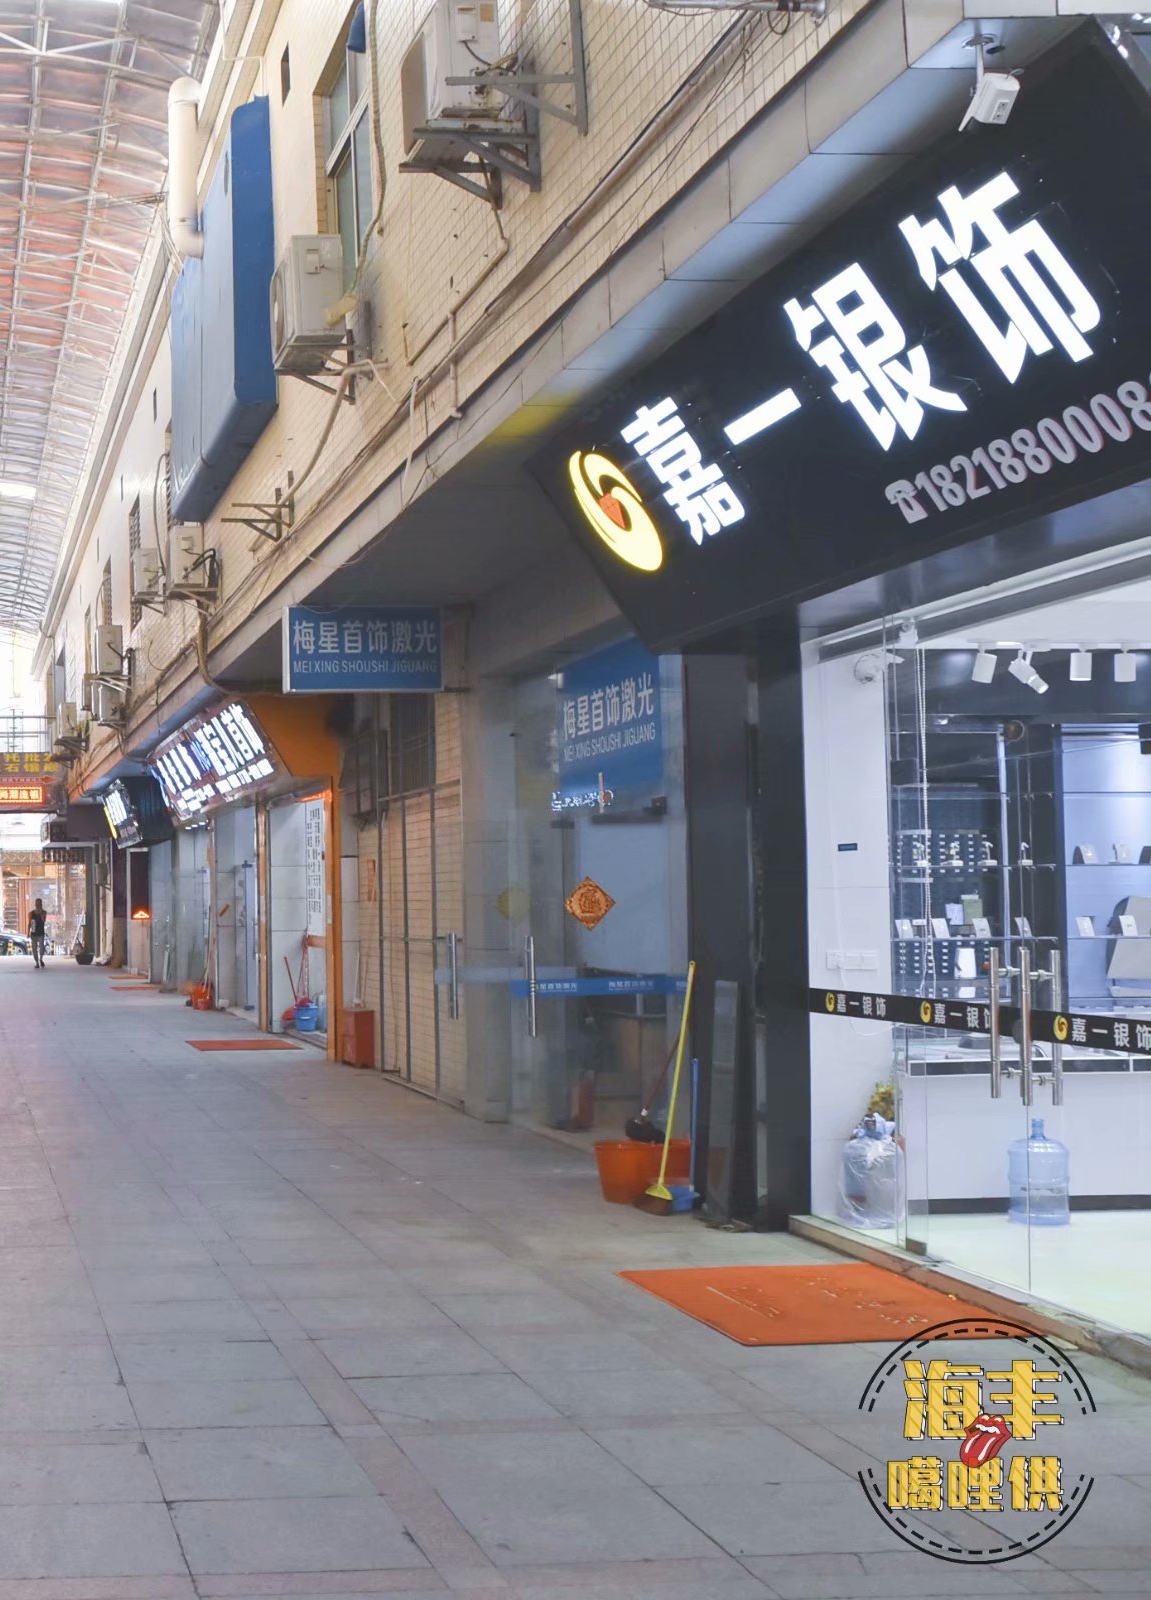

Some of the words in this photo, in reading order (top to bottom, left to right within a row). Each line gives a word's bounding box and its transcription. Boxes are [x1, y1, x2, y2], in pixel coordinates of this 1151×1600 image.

[620, 172, 1101, 546] 嘉一银饰
[914, 372, 1151, 513] 1821880008
[293, 620, 437, 655] 梅星首饰激光
[293, 660, 312, 673] MEI
[315, 660, 339, 673] XING
[342, 660, 389, 673] SHOUSHI
[392, 660, 437, 673] JIGUANG
[563, 672, 654, 741] 梅星首饰激光
[575, 740, 591, 758] XING
[592, 732, 621, 756] SHOUSHI
[623, 722, 655, 748] JIGUANG
[837, 993, 887, 1018] 嘉一银饰
[1071, 1017, 1151, 1051] 嘉一银饰
